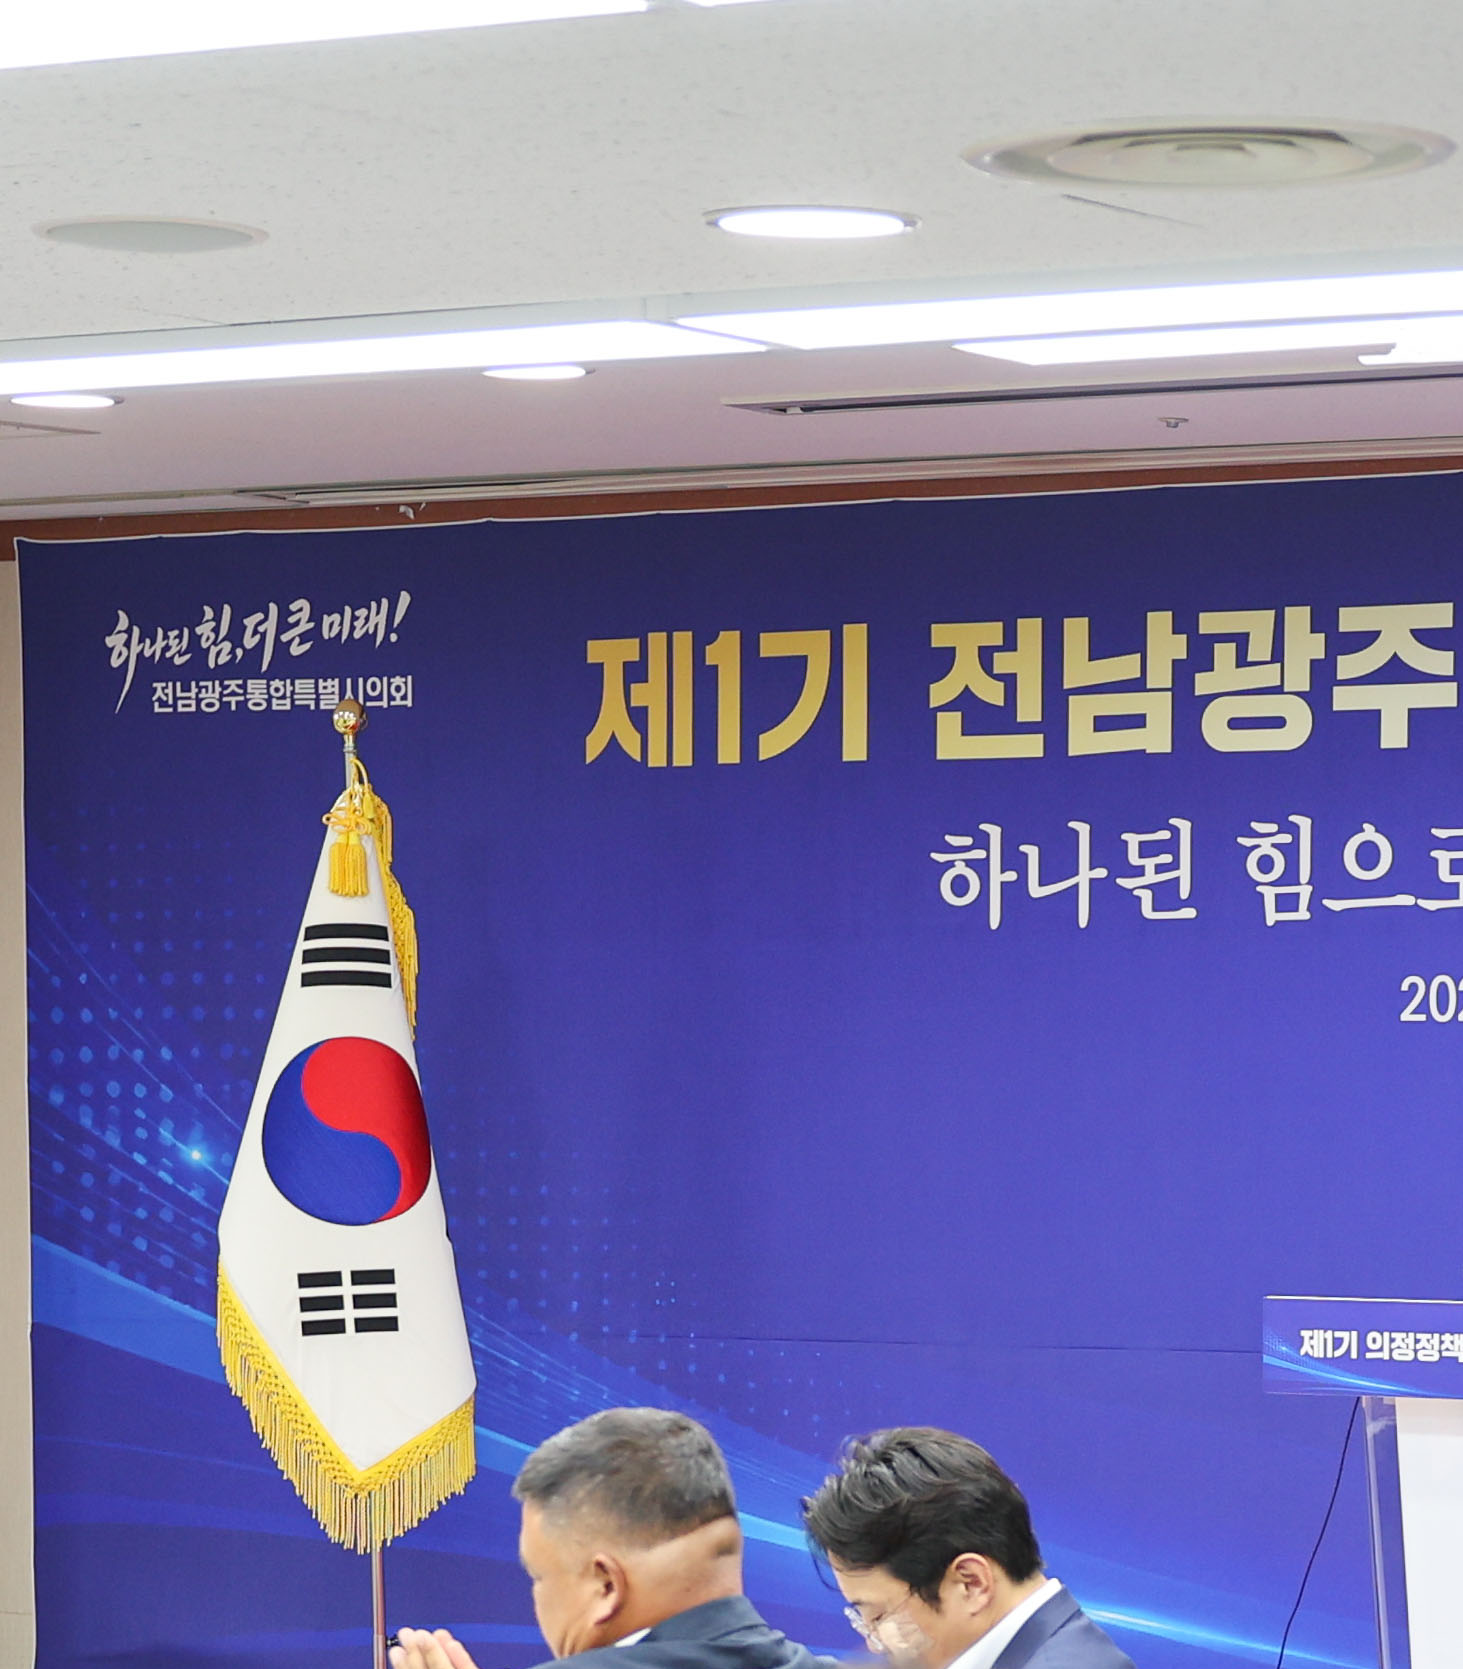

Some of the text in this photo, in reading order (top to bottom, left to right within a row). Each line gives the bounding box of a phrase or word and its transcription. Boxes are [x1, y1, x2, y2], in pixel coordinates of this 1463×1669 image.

[104, 608, 193, 715] 하나된
[242, 601, 279, 674] 더
[280, 597, 316, 657] 큰
[321, 590, 412, 650] 미래!
[150, 674, 413, 714] 전남광주통합특별시의회
[584, 622, 870, 768] 제1기
[929, 816, 1198, 931] 하나된
[1299, 1329, 1359, 1360] 제1기
